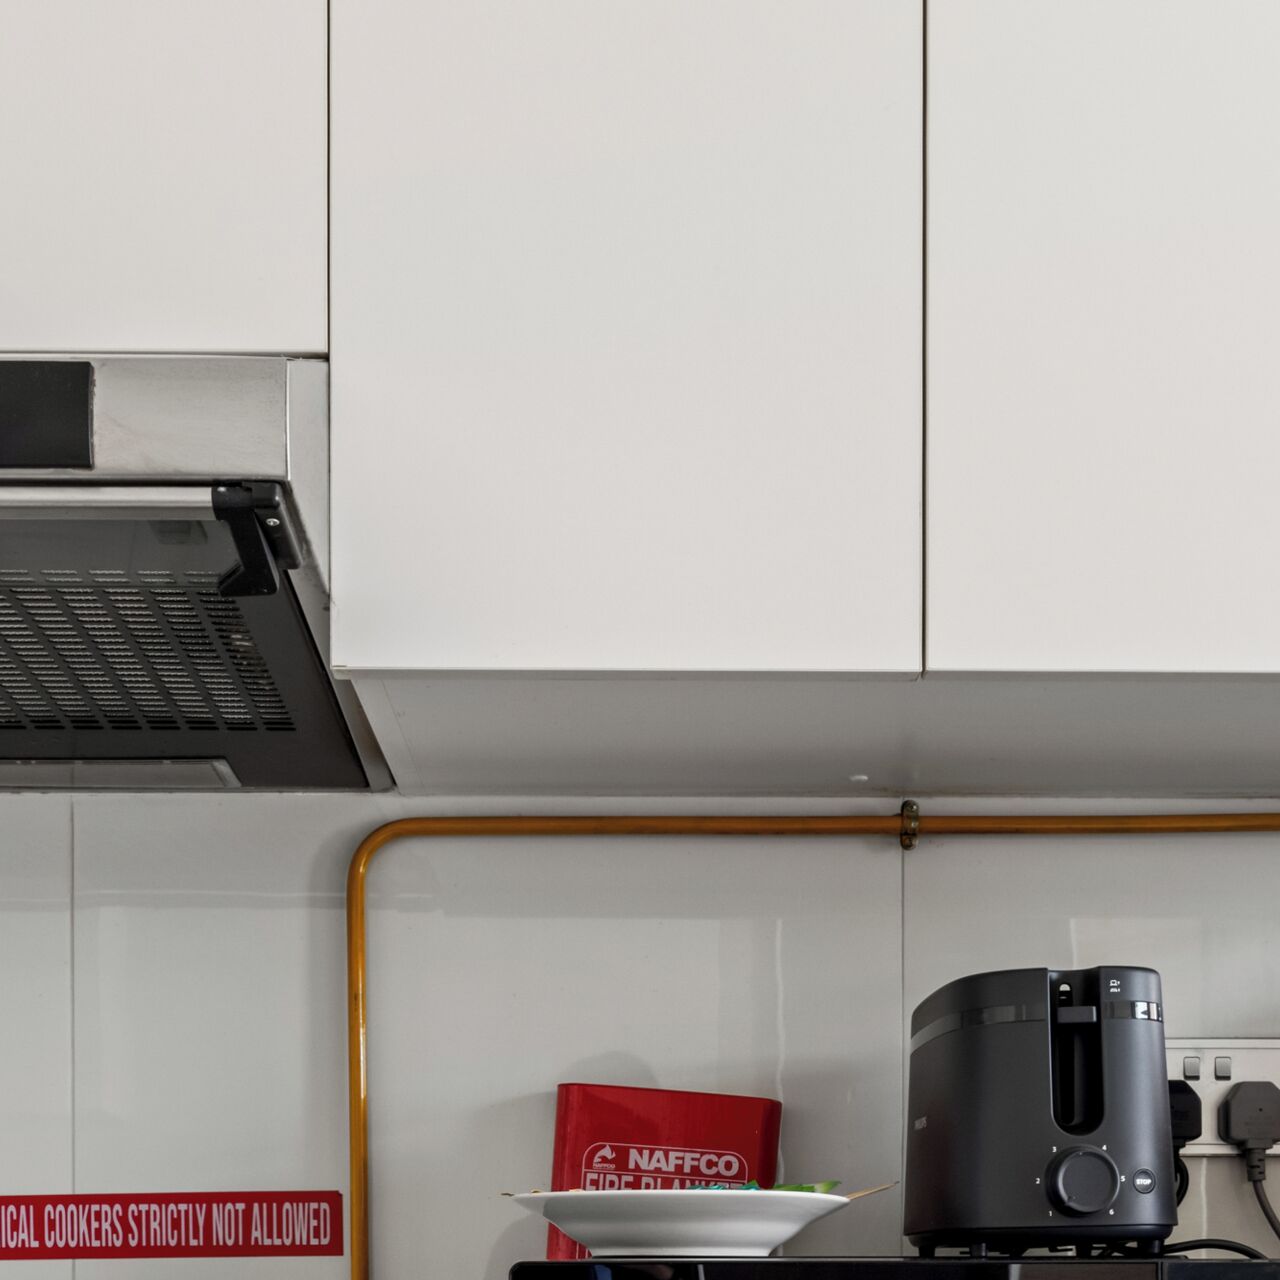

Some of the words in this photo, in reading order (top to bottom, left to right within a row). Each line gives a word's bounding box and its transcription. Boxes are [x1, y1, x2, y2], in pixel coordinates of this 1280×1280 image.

[628, 1148, 739, 1177] NAFFCO
[1136, 1178, 1152, 1186] STOP
[1109, 1208, 1115, 1216] 6
[43, 1203, 123, 1248] COOKERS
[127, 1203, 206, 1248] STRICTLY
[211, 1203, 245, 1247] NOT
[250, 1201, 331, 1246] ALLOWED
